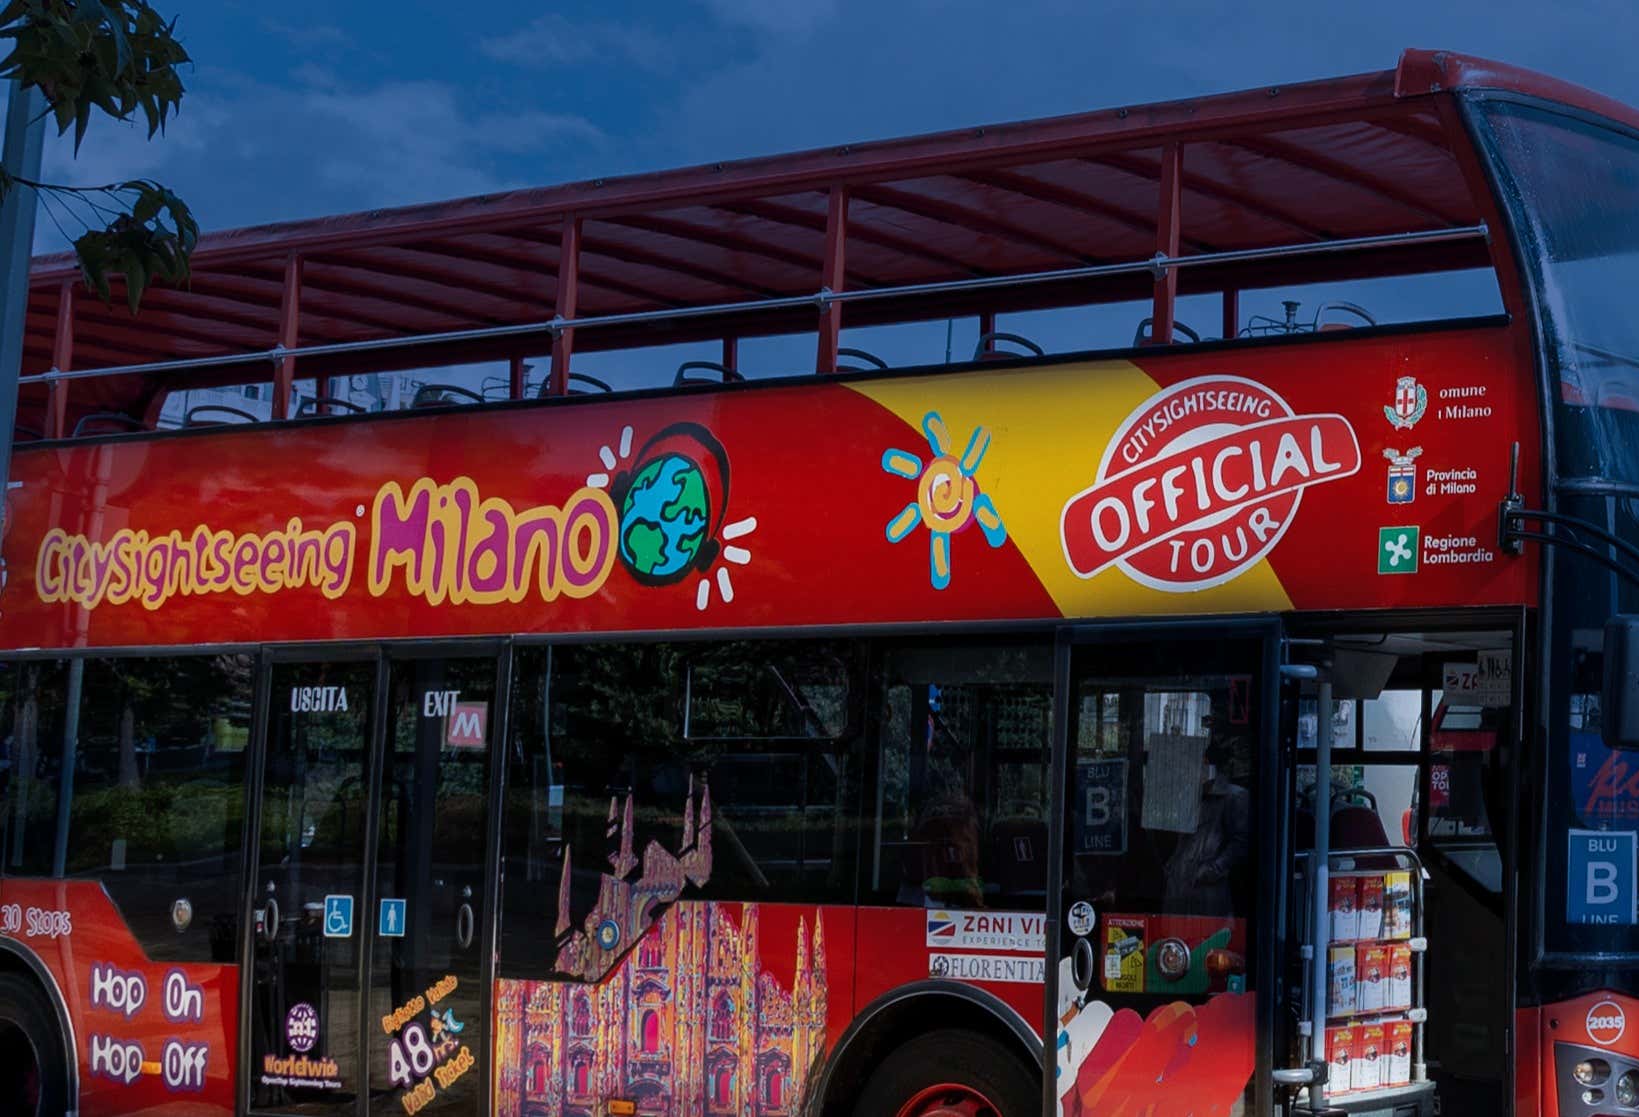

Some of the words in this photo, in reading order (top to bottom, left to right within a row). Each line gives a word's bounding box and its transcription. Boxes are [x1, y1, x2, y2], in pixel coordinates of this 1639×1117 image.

[1445, 405, 1492, 420] Milano
[1122, 389, 1273, 464] CITYSIGHTSEEING
[1426, 467, 1477, 481] Provincia
[1090, 424, 1343, 554] OFFICIAL
[1426, 482, 1437, 496] di
[1440, 482, 1477, 495] Milano
[1169, 507, 1281, 574] TOUR
[1424, 534, 1477, 550] Regione
[36, 517, 356, 611] CitySightseeing
[1423, 549, 1494, 564] Lombardia
[290, 685, 349, 713] USCITA
[424, 690, 461, 717] EXIT
[1085, 786, 1111, 826] B
[1083, 834, 1113, 849] LINE
[1588, 839, 1618, 852] BLU
[1585, 861, 1619, 905] B
[0, 903, 21, 934] 30
[26, 906, 72, 939] Stops
[963, 915, 1012, 935] ZANI
[949, 957, 1046, 981] FLORENTIA
[92, 966, 146, 1016] Hop
[165, 971, 202, 1019] On
[1588, 1016, 1624, 1029] 2035
[91, 1035, 144, 1084] Hop
[164, 1040, 208, 1087] Off
[389, 1023, 434, 1087] 48
